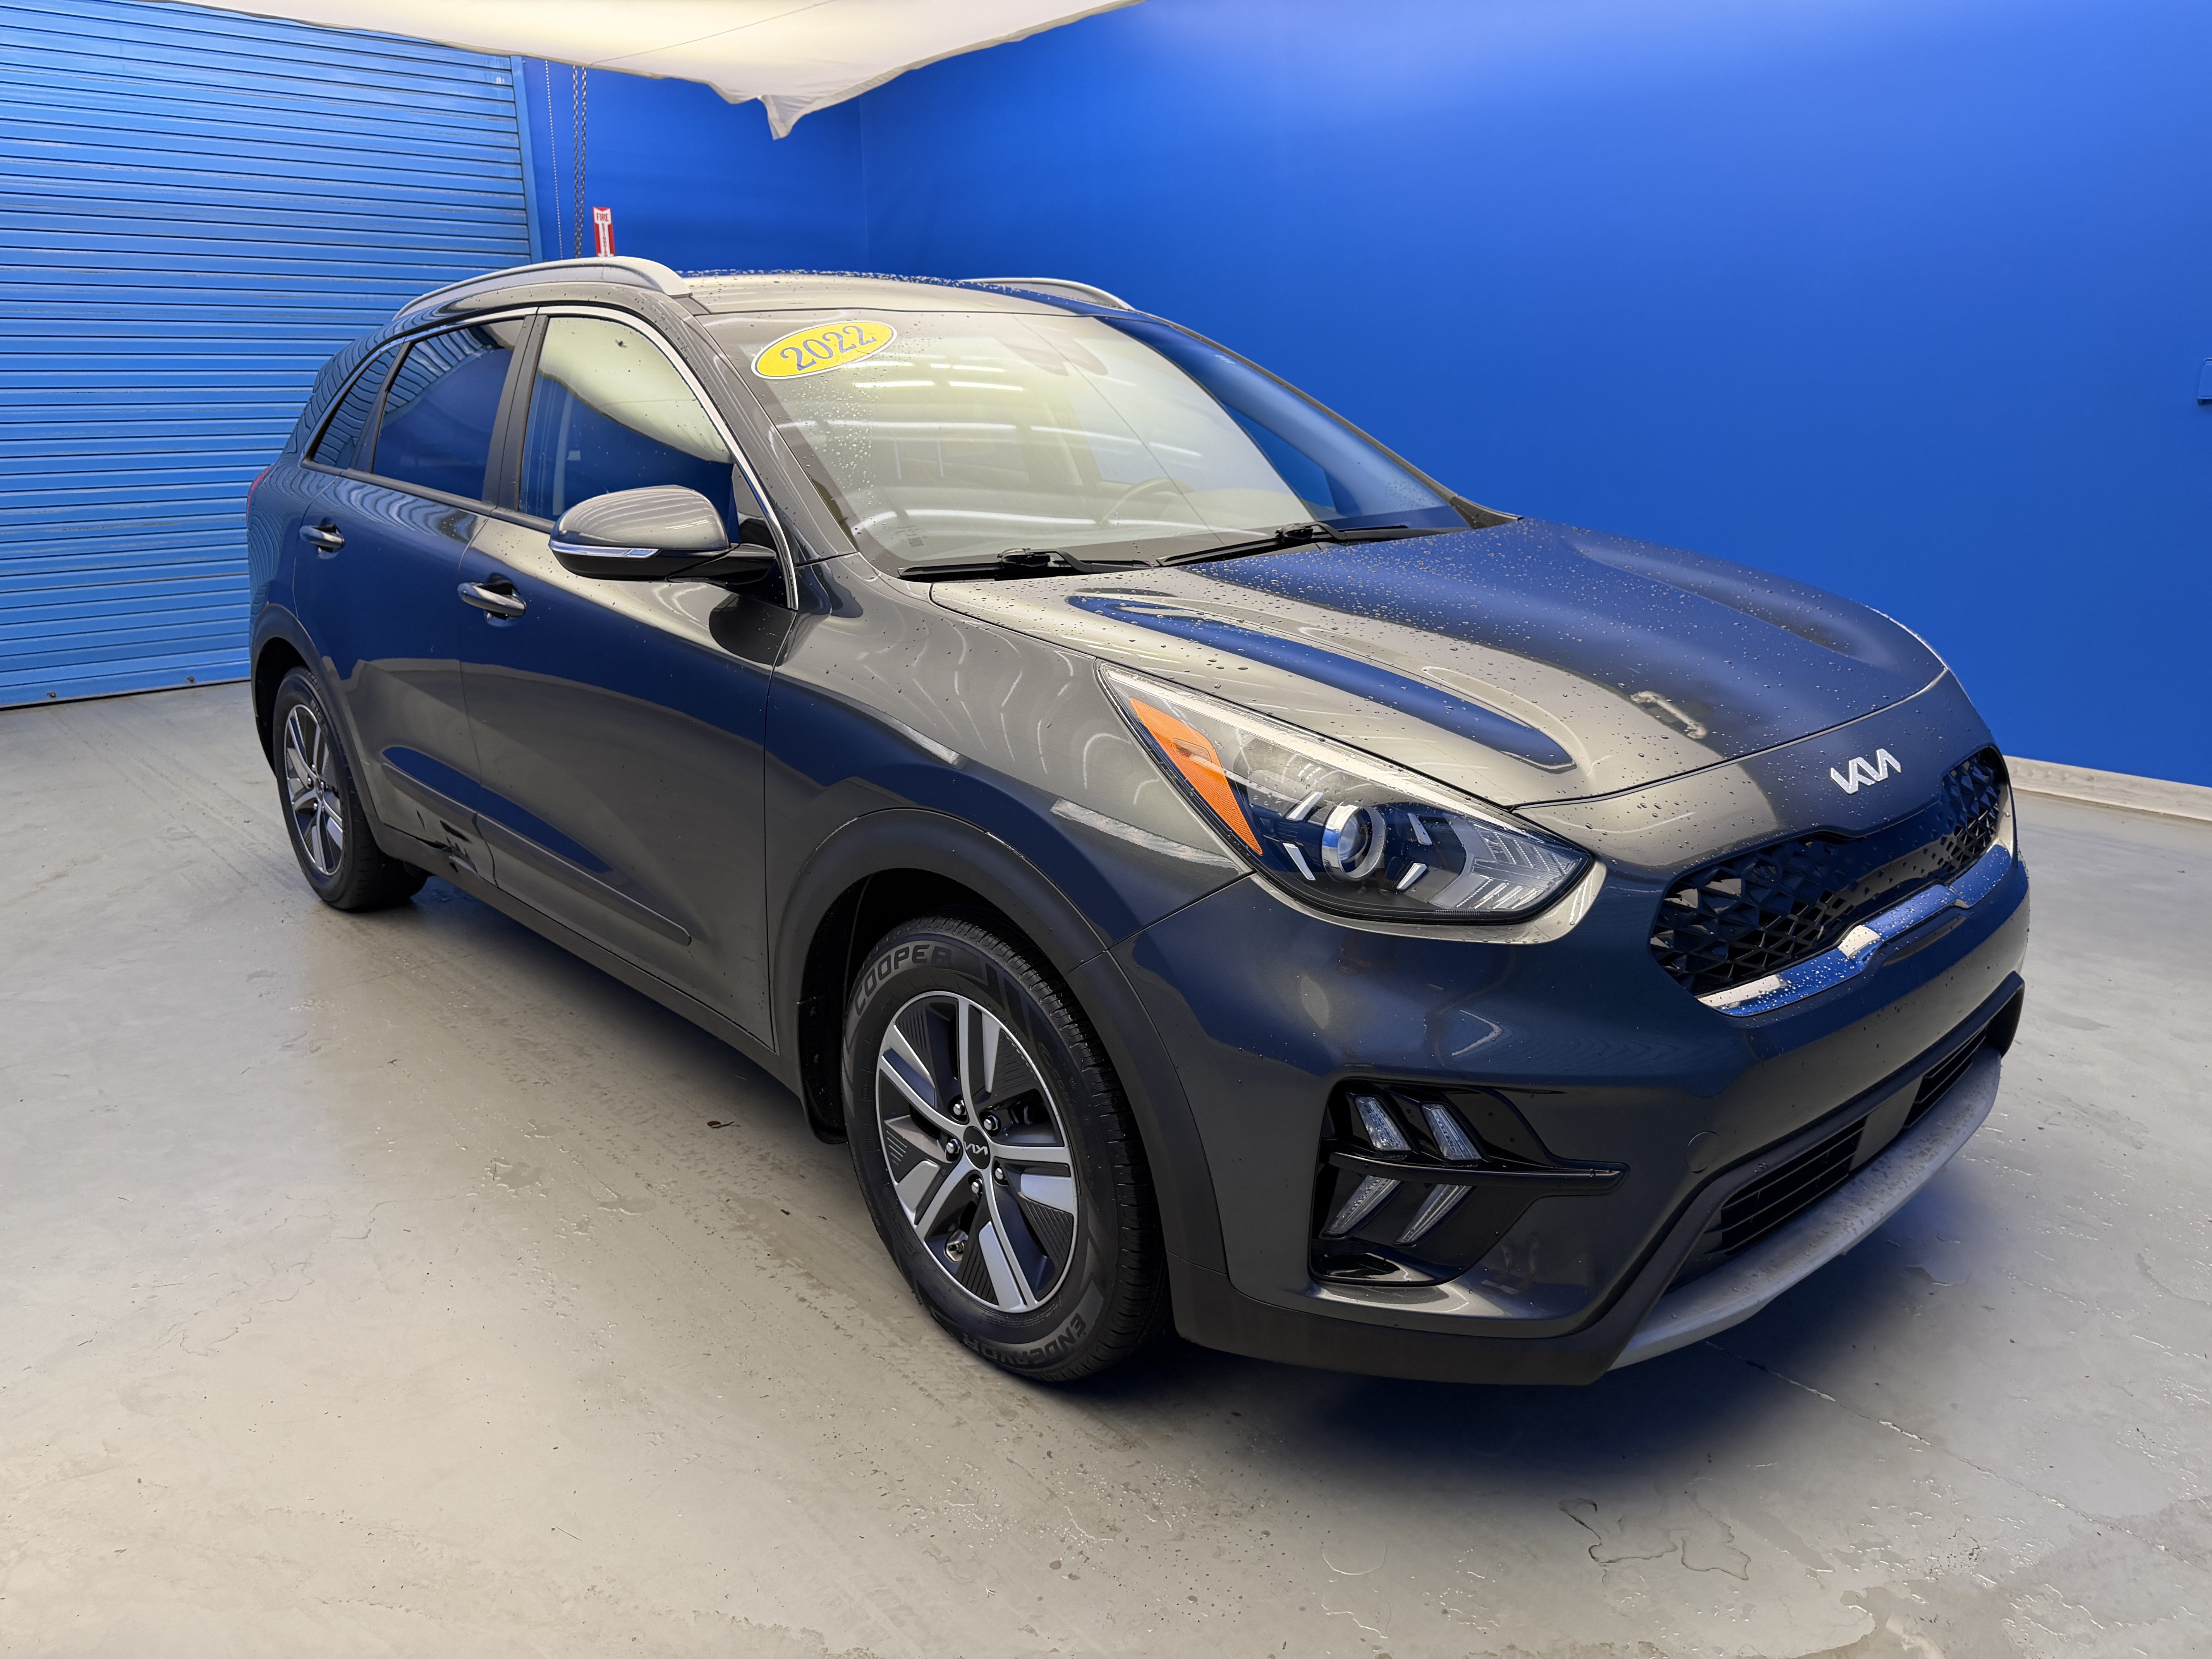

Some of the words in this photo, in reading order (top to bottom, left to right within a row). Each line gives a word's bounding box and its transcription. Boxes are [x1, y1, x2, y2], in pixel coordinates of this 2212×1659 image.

[596, 213, 609, 222] FIRE
[780, 325, 877, 371] 2022
[1830, 748, 1901, 795] KIA
[855, 944, 952, 1016] COOPER
[962, 1312, 1087, 1366] ENDEAVOR
